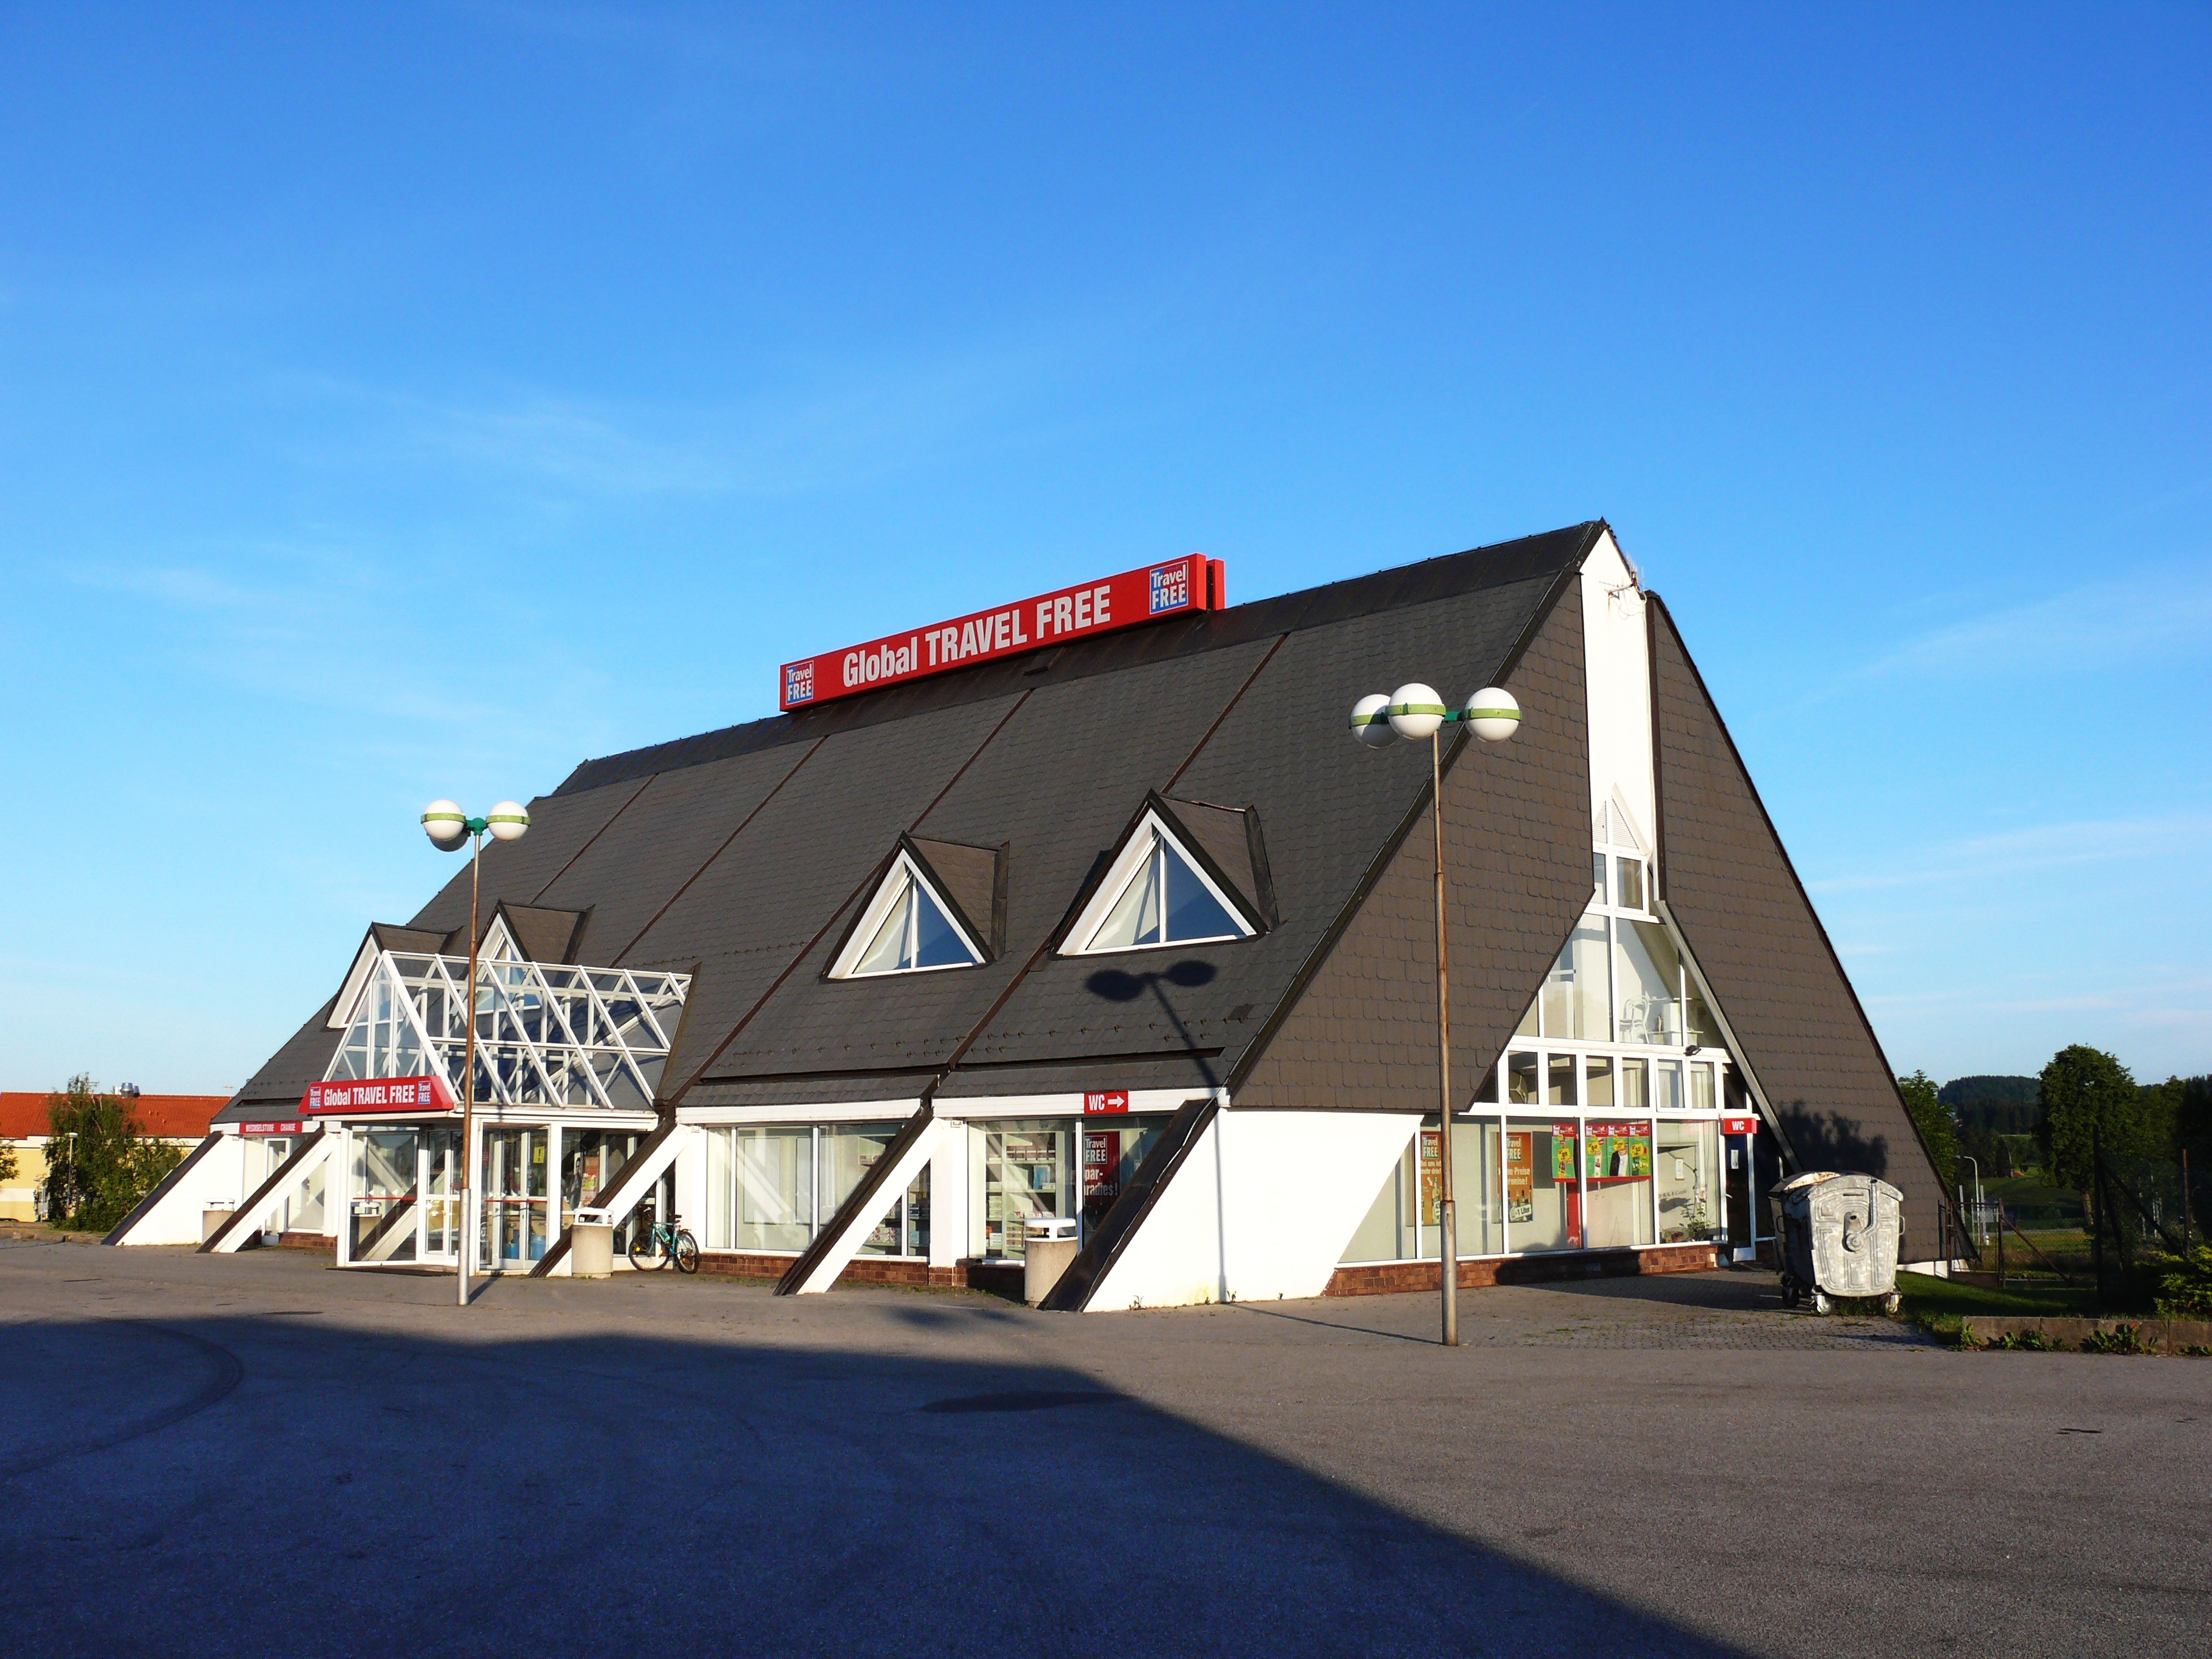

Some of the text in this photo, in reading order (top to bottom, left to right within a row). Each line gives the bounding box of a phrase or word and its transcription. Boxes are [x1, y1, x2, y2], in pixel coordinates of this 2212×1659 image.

[1151, 564, 1187, 588] Travel
[1152, 583, 1187, 610] FREE
[843, 585, 1111, 688] Global TRAVEL FREE
[787, 663, 813, 683] Travel
[787, 679, 812, 702] FREE
[310, 1088, 321, 1097] Travel
[418, 1082, 431, 1091] Travel
[324, 1084, 415, 1107] Global TRAVEL FREE
[418, 1092, 431, 1102] FREE
[310, 1097, 321, 1107] FREE
[1088, 1094, 1105, 1111] WC
[1732, 1121, 1745, 1131] WC
[1085, 1138, 1107, 1149] Travel
[1423, 1137, 1438, 1146] Travel
[1085, 1150, 1107, 1162] FREE
[1423, 1146, 1439, 1158] FREE
[1085, 1168, 1104, 1182] par-
[1514, 1167, 1530, 1176] Preise
